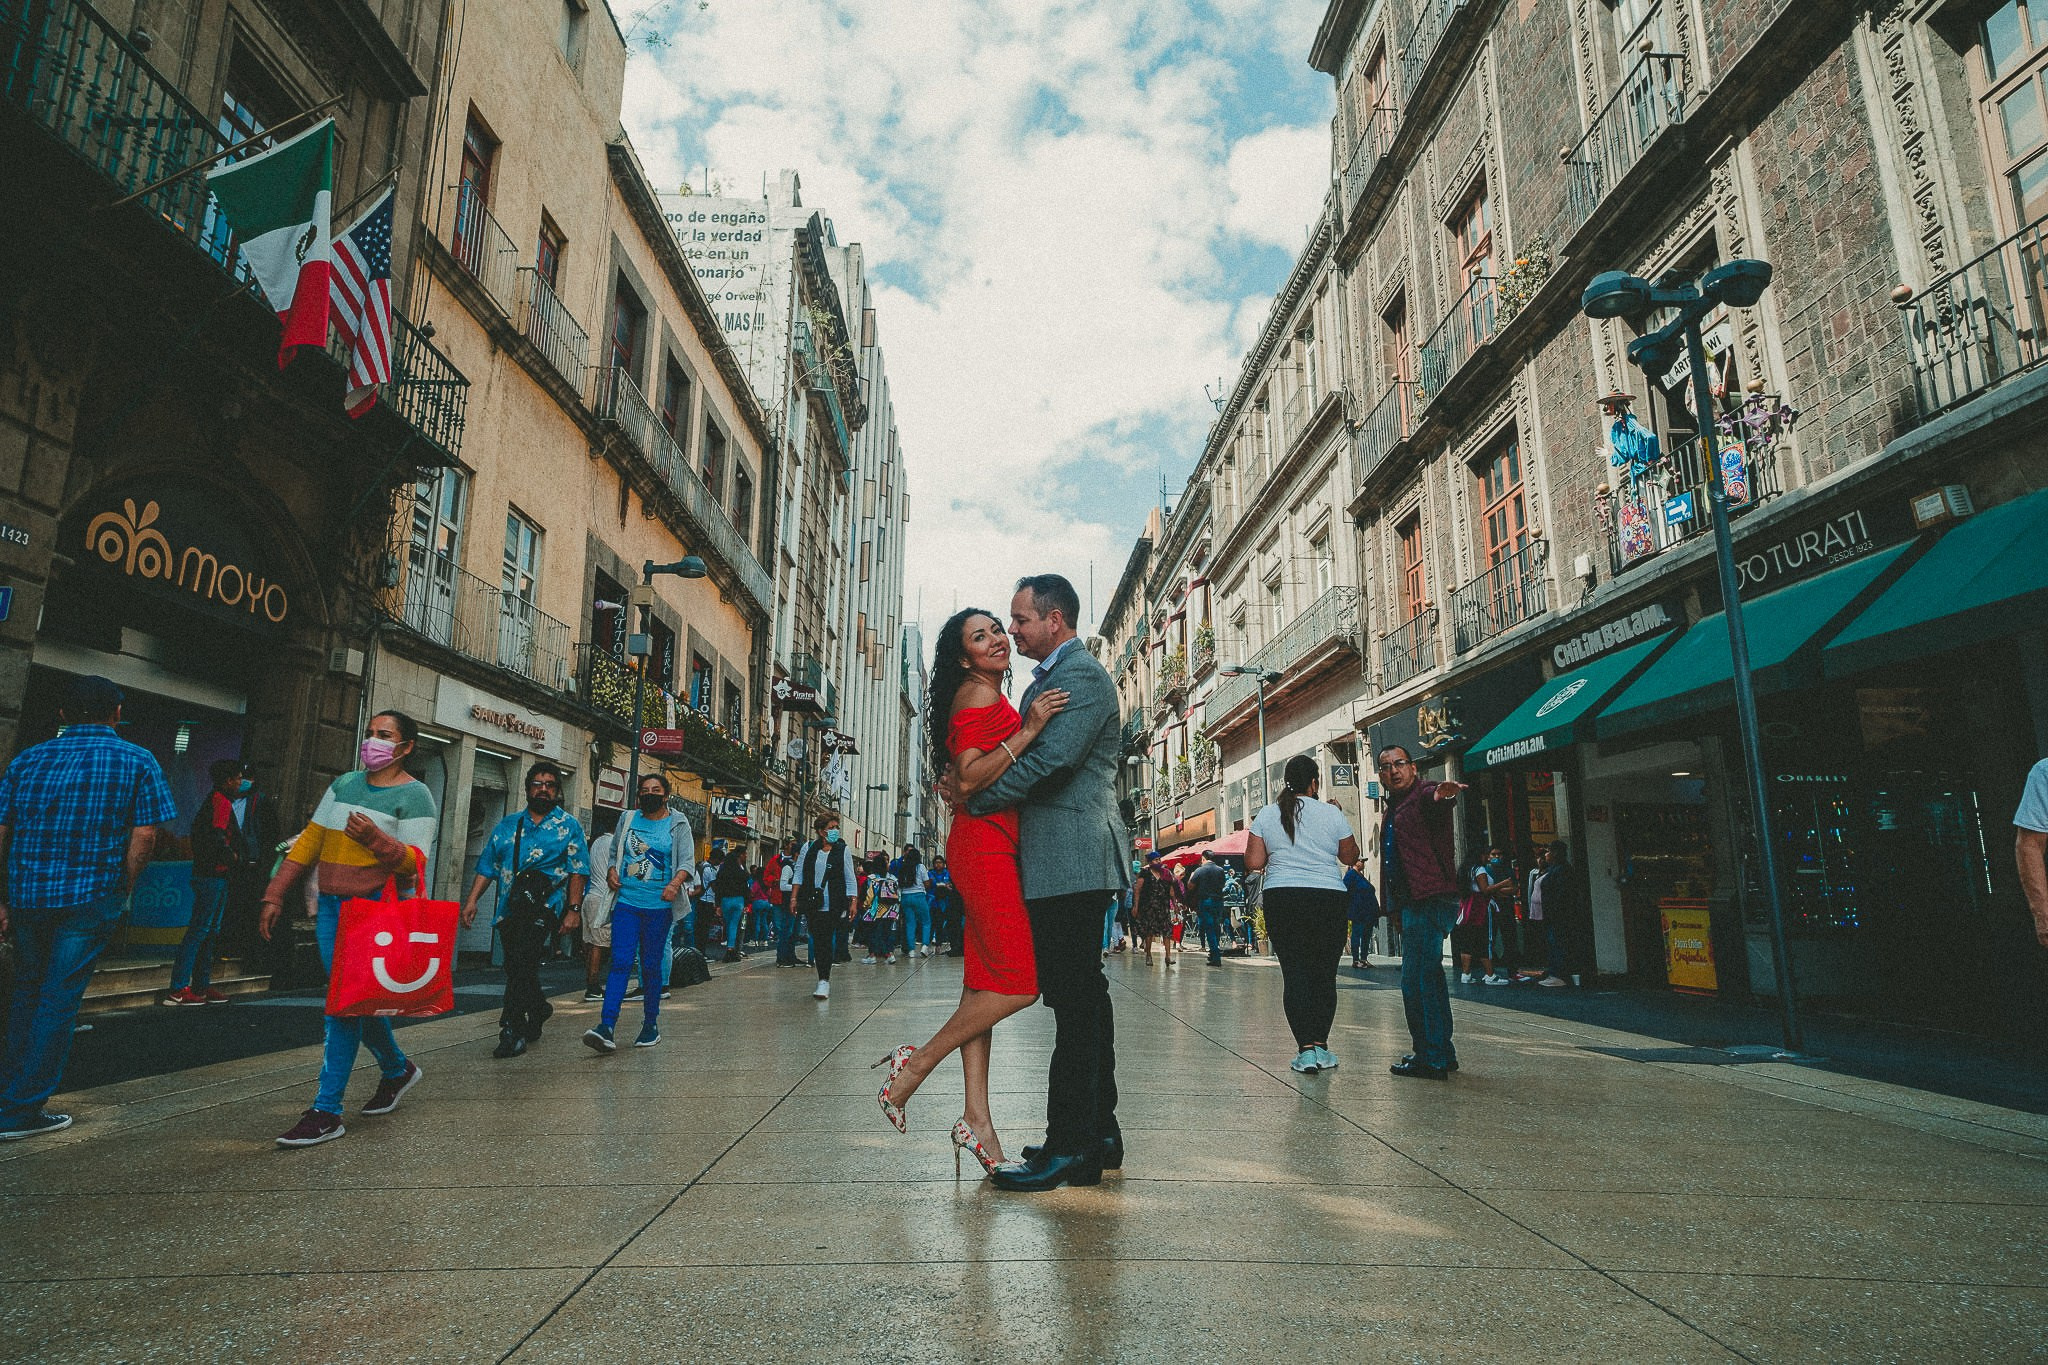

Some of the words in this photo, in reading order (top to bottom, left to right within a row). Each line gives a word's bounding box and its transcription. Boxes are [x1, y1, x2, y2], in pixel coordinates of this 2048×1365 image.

[688, 211, 706, 223] de
[711, 211, 766, 226] engaño
[692, 229, 706, 241] la
[711, 230, 762, 242] verdad
[708, 249, 726, 260] en
[731, 249, 749, 260] un
[724, 312, 750, 331] MAS
[1, 525, 30, 546] 1423
[1828, 547, 1855, 564] DESDE
[1855, 540, 1874, 553] 1923
[793, 690, 815, 699] Pirates
[472, 704, 509, 729] SANTA
[518, 721, 546, 740] CLARA
[1796, 774, 1849, 783] OAKLEY
